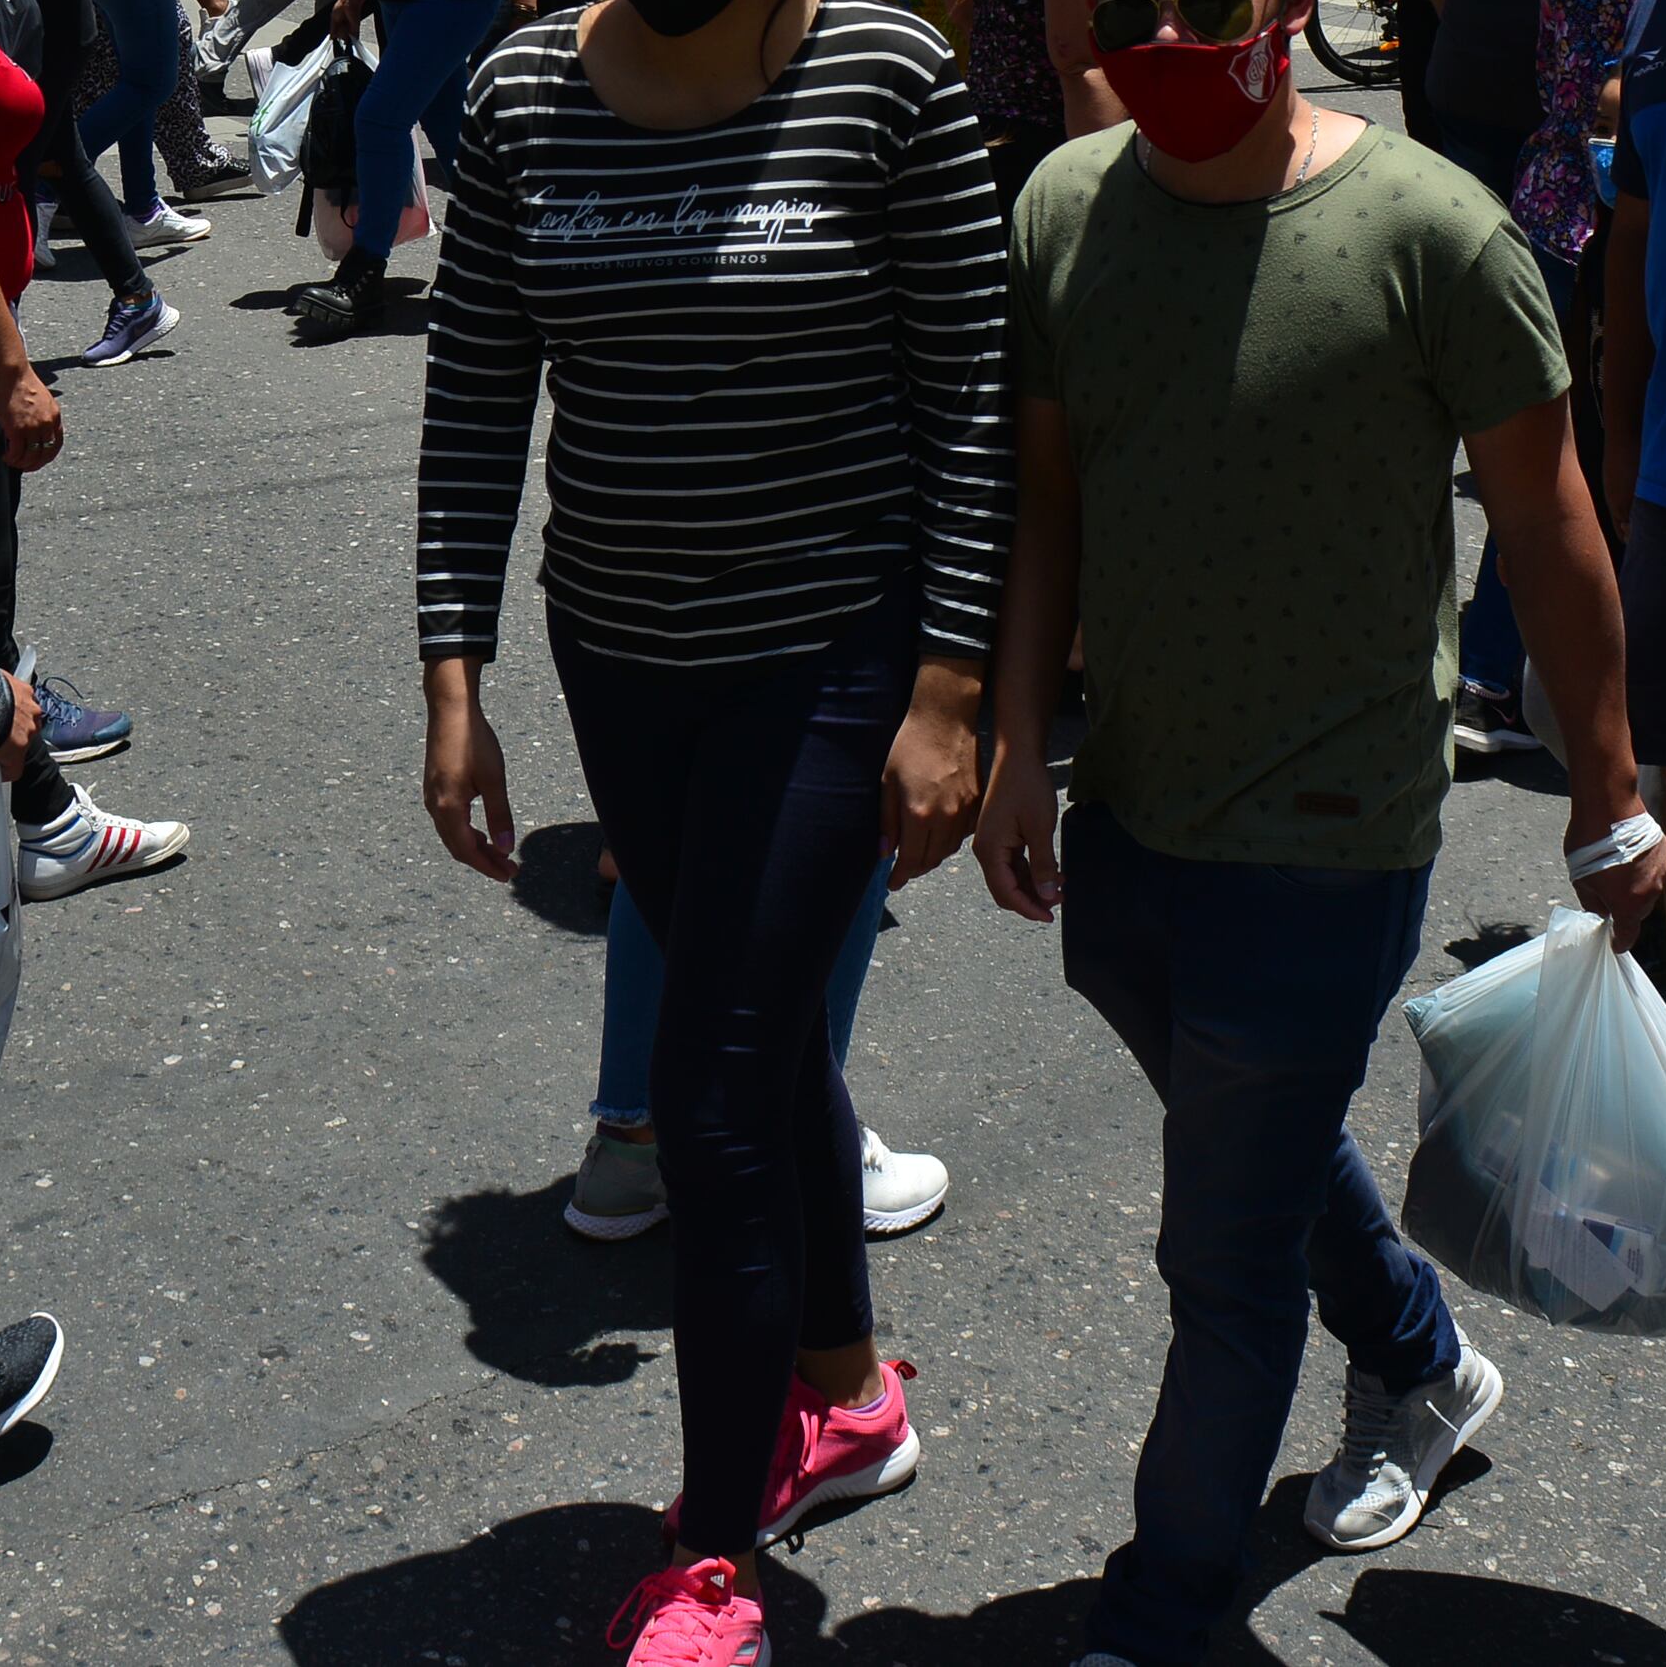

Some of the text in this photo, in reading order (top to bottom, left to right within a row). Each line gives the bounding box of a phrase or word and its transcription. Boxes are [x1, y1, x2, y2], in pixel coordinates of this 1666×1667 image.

[620, 209, 667, 234] en
[672, 183, 715, 236] la
[724, 197, 822, 244] magia
[560, 253, 768, 272] DE LOS NUEVOS COMIENZOS
